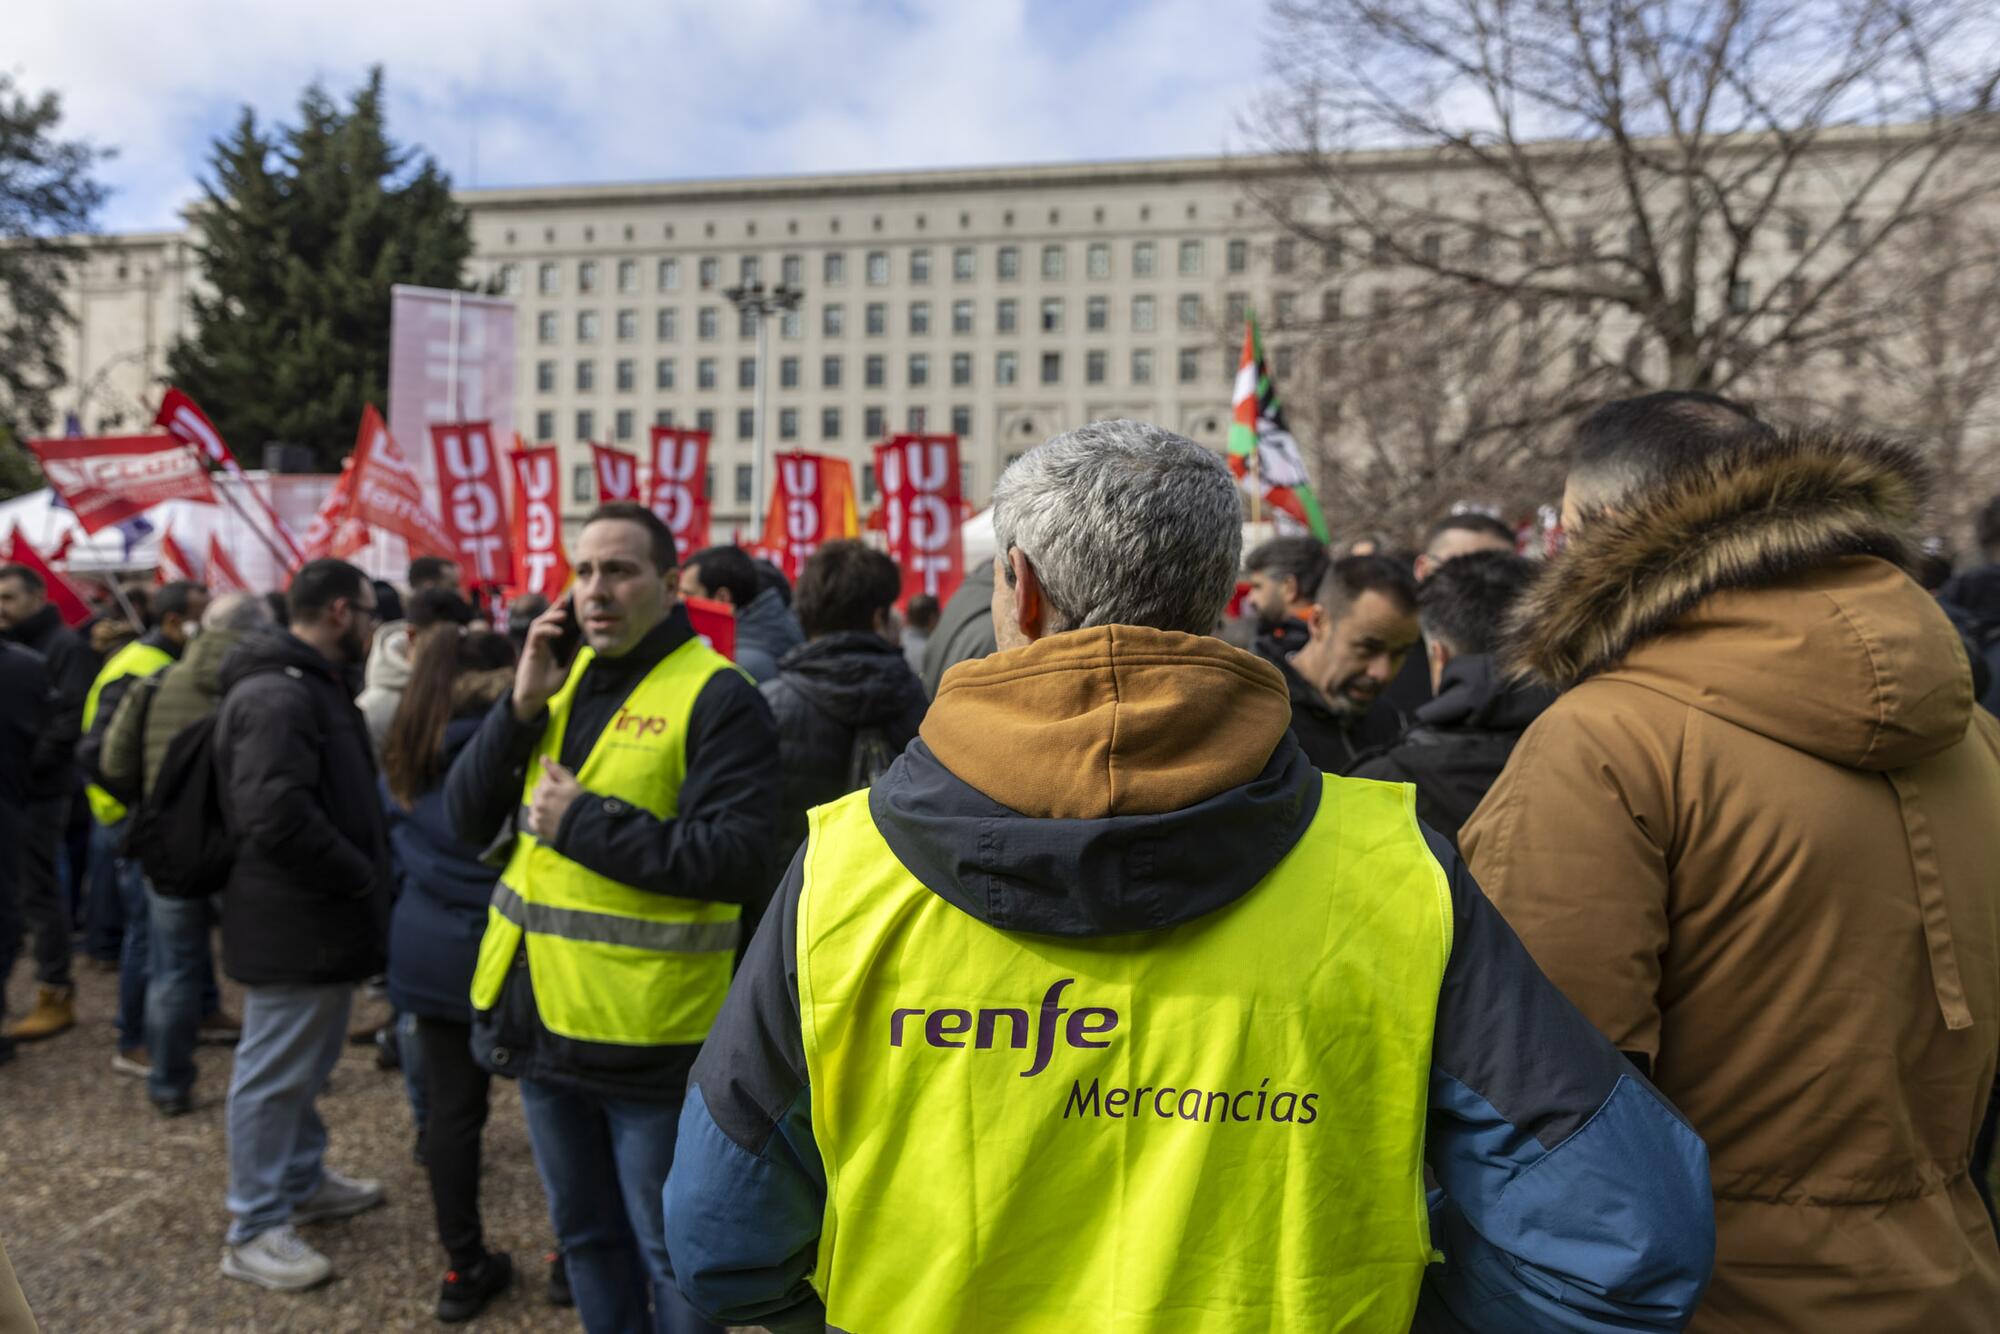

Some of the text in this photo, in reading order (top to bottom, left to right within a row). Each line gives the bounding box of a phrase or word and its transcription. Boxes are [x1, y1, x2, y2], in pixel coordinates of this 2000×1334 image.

[615, 706, 667, 738] iryo
[890, 978, 1119, 1077] renfe
[1063, 1077, 1319, 1125] Mercancías
